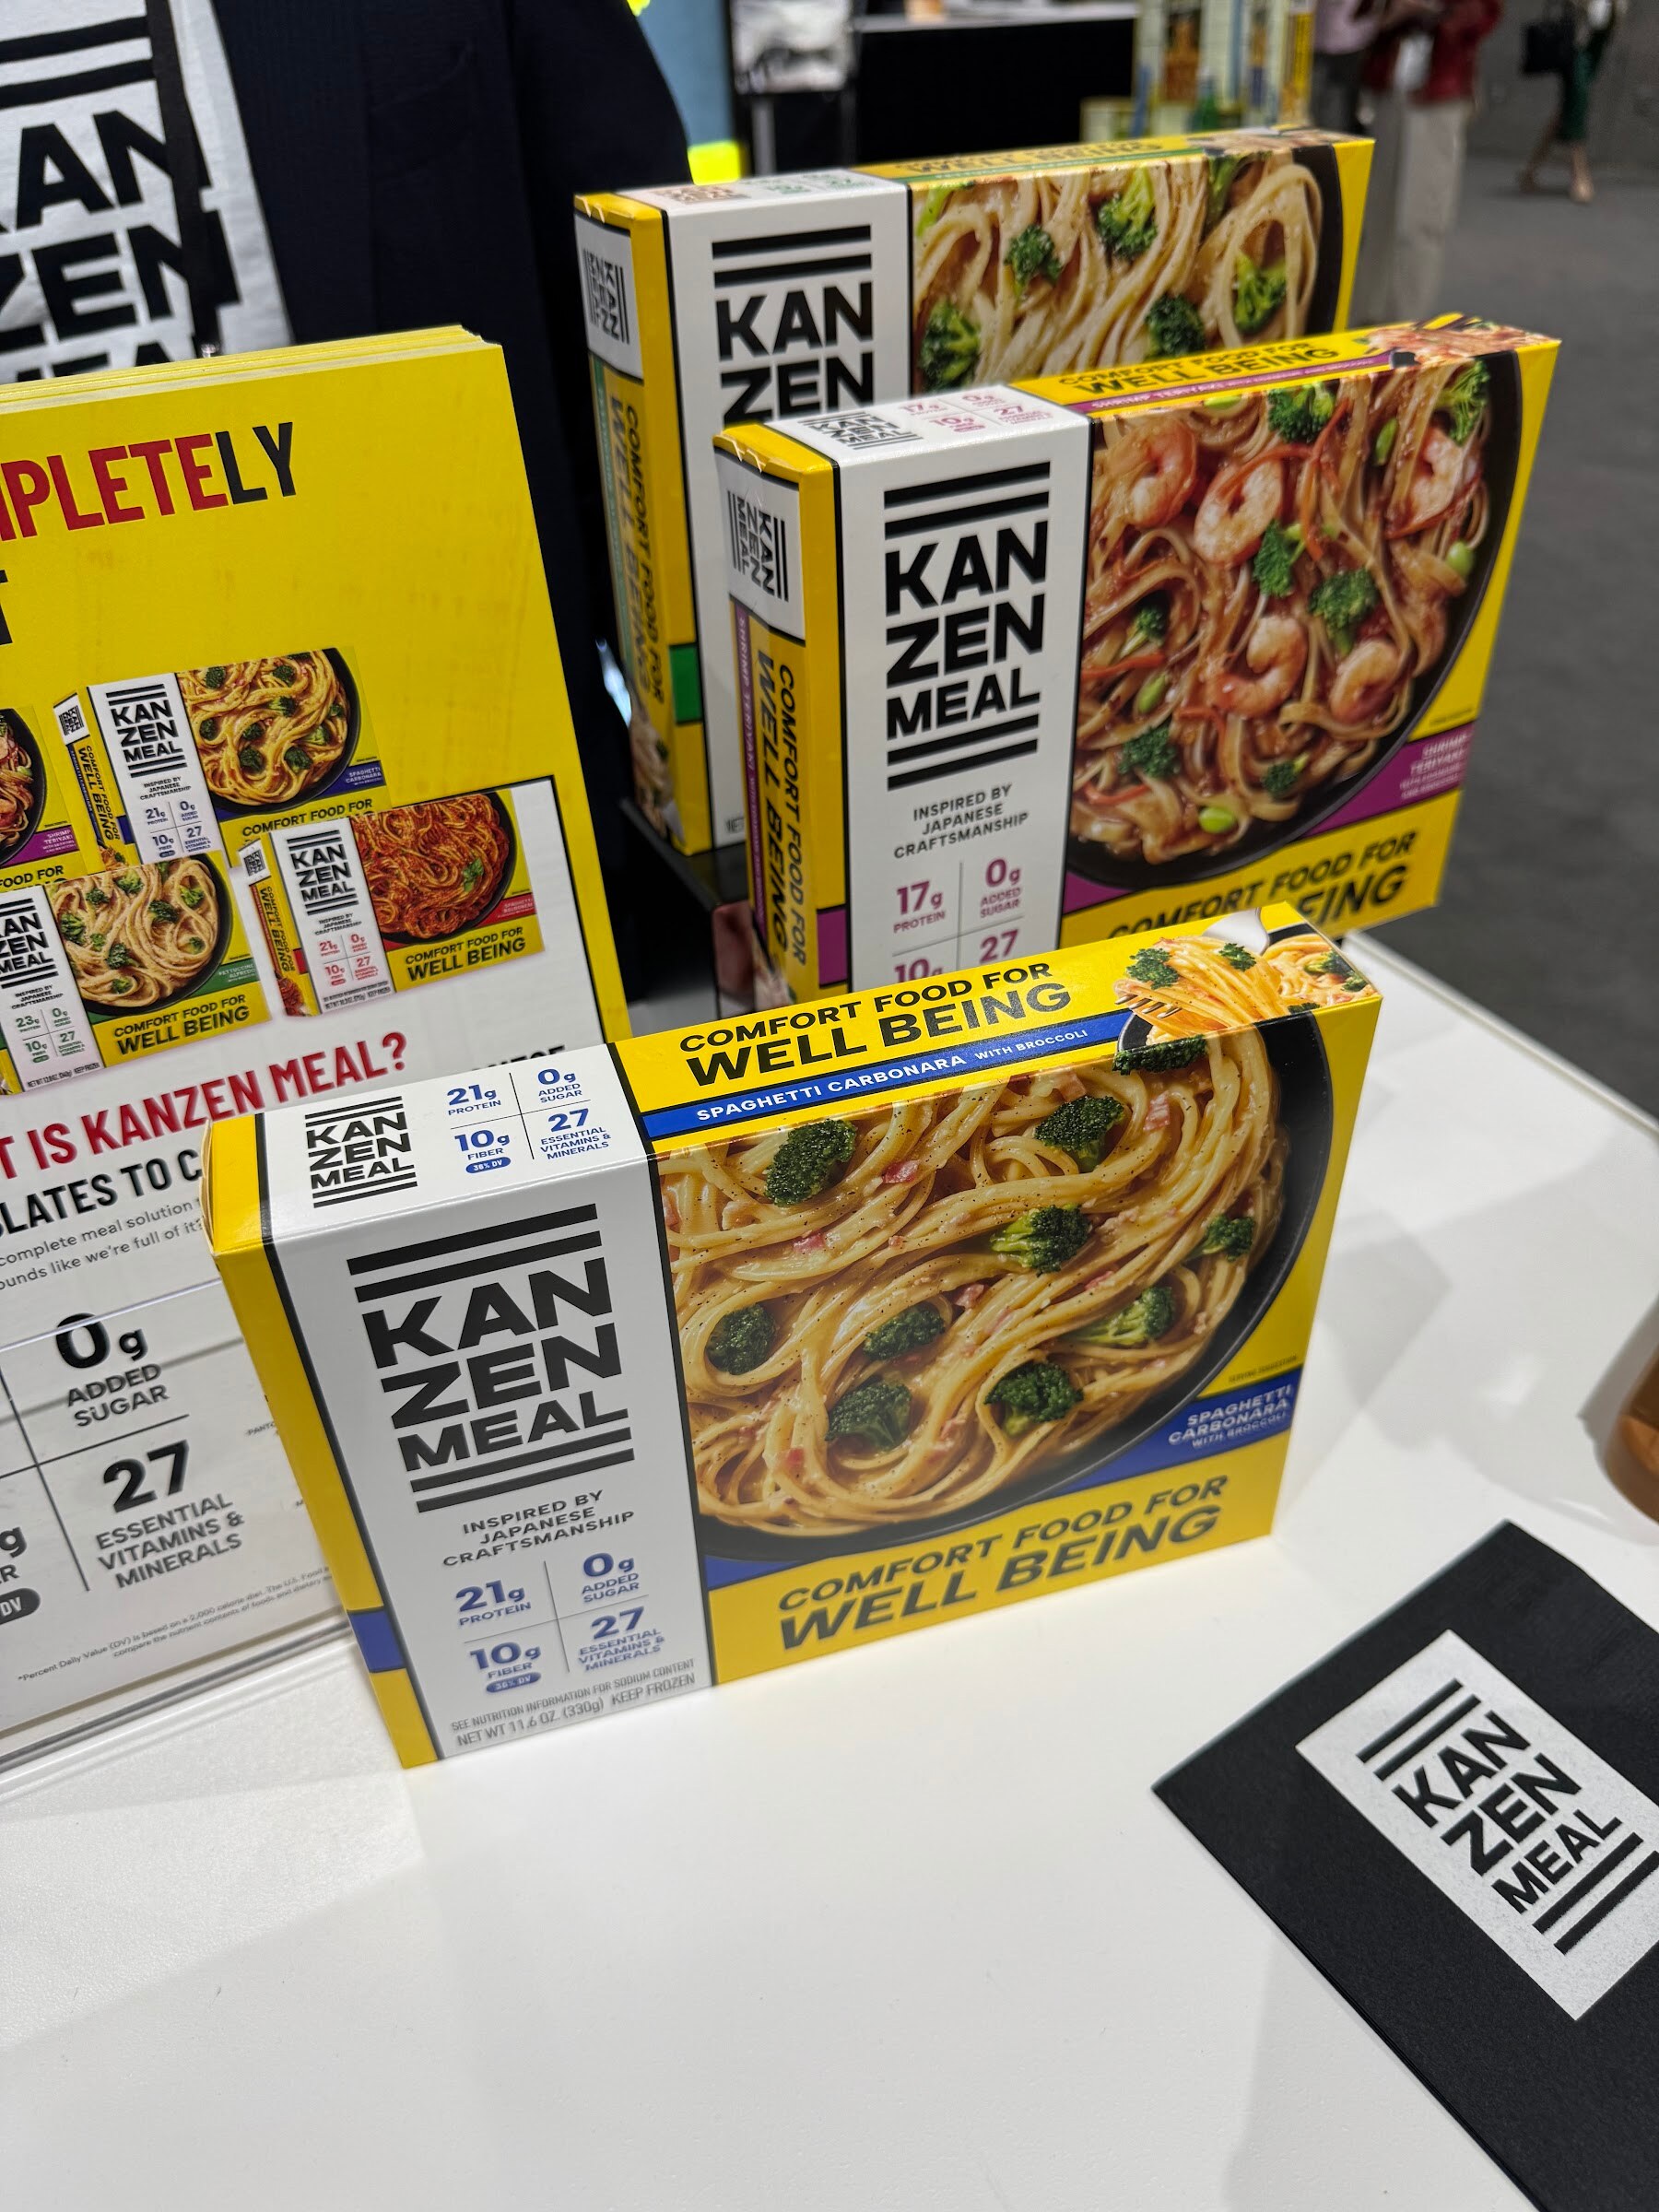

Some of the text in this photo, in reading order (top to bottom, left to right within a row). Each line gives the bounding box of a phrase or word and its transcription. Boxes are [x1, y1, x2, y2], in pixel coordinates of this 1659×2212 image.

[0, 97, 212, 232] AN
[716, 281, 873, 361] KAN
[721, 351, 873, 427] ZEN
[1059, 362, 1182, 384] COMFORT
[1074, 371, 1207, 394] WELL
[1205, 349, 1338, 375] BEING
[808, 415, 887, 431] KAN
[824, 422, 901, 439] ZEN
[837, 430, 912, 445] MEAL
[0, 421, 296, 542] PLETELY
[627, 405, 665, 704] COMFORT FOOD FOR
[736, 497, 749, 576] MEAL
[746, 501, 761, 587] ZEN
[758, 510, 775, 596] KAN
[885, 520, 1048, 618] KAN
[886, 593, 1045, 689] ZEN
[111, 699, 173, 726] KAN
[757, 649, 781, 789] WELL
[887, 666, 1041, 741] MEAL
[117, 719, 180, 747] ZEN
[123, 740, 182, 763] MEAL
[77, 747, 94, 790] WELL
[92, 793, 114, 841] BEING
[913, 783, 1013, 821] INSPIRED BY
[186, 826, 202, 838] 27
[242, 799, 372, 837] COMFORT FOOD FOR
[780, 664, 806, 966] COMFORT FOOD FOR
[922, 803, 1003, 835] JAPANESE
[893, 811, 1030, 859] CRAFTSMANSHIP
[37, 865, 64, 879] FOR
[289, 844, 348, 870] KAN
[296, 862, 352, 888] ZEN
[766, 798, 788, 953] BEING
[984, 857, 1021, 888] 0g
[1269, 852, 1353, 899] FOOD
[1359, 830, 1416, 867] FOR
[300, 881, 356, 902] MEAL
[896, 880, 943, 915] 17g
[980, 888, 1021, 906] ADDED
[980, 899, 1021, 918] SUGAR
[260, 888, 290, 971] WELL BEING
[893, 911, 946, 934] PROTEIN
[357, 956, 371, 968] 27
[406, 926, 524, 965] COMFORT FOOD FOR
[407, 958, 464, 982] WELL
[467, 937, 525, 966] BEING
[979, 928, 1019, 964] 27
[114, 994, 246, 1038] COMFORT FOOD FOR
[679, 961, 1053, 1053] COMFORT FOOD FOR
[60, 1030, 76, 1042] 27
[117, 1029, 180, 1055] WELL
[184, 1006, 250, 1037] BEING
[686, 982, 1072, 1088] WELL BEING
[447, 1084, 497, 1105] 21g
[537, 1068, 576, 1085] 0g
[538, 1083, 581, 1096] ADDED
[696, 1029, 1088, 1122] SPAGHETTI CARBONARA WITH BROCCOLI
[27, 1032, 407, 1170] IS KANZEN MEAL?
[448, 1100, 501, 1115] PROTEIN
[540, 1090, 582, 1103] SUGAR
[307, 1112, 409, 1149] KAN
[541, 1126, 606, 1145] ESSENTIAL
[547, 1108, 589, 1133] 27
[308, 1133, 412, 1171] ZEN
[454, 1130, 510, 1152] 10g
[467, 1147, 504, 1160] FIBER
[540, 1135, 599, 1152] VITAMINS
[547, 1141, 609, 1159] MINERALS
[311, 1157, 414, 1190] MEAL
[0, 1158, 172, 1238] LATES TO
[82, 1219, 123, 1241] meal
[127, 1202, 193, 1229] solution
[51, 1225, 180, 1275] like we're full of
[362, 1256, 613, 1370] KAN
[55, 1312, 148, 1369] 0g
[67, 1363, 161, 1407] ADDED
[381, 1322, 622, 1430] ZEN
[75, 1384, 170, 1427] SUGAR
[1168, 1398, 1288, 1445] CARBONARA
[1188, 1384, 1292, 1427] SPAGHETTI
[397, 1390, 629, 1472] MEAL
[1192, 1412, 1286, 1449] WITH BROCCOLI
[103, 1440, 190, 1512] 27
[96, 1493, 233, 1549] ESSENTIAL
[463, 1489, 603, 1535] INSPIRED BY
[479, 1506, 595, 1545] JAPANESE
[98, 1510, 245, 1571] VITAMINS &
[442, 1511, 635, 1568] CRAFTSMANSHIP
[778, 1475, 1228, 1612] COMFORT FOOD FOR
[115, 1533, 242, 1589] MINERALS
[582, 1552, 635, 1578] 0g
[779, 1505, 1221, 1652] WELL BEING
[455, 1580, 525, 1613] 21g
[582, 1571, 639, 1594] ADDED
[582, 1582, 641, 1604] SUGAR
[459, 1601, 532, 1627] PROTEIN
[591, 1606, 644, 1641] 27
[59, 1653, 81, 1668] Daily
[83, 1646, 108, 1659] Value
[469, 1641, 542, 1671] 10g
[578, 1635, 665, 1665] VITAMINS &
[579, 1628, 662, 1654] ESSENTIAL
[584, 1645, 662, 1672] MINERALS
[488, 1662, 533, 1679] FIBER
[518, 1674, 531, 1685] DV
[452, 1658, 695, 1732] SEE NUTRITION INFORMATION FOR SODIUM CONTENT
[456, 1673, 696, 1747] NET WT 11.6 (330g) KEEP FROZEN
[1391, 1710, 1531, 1829] KAN
[1440, 1752, 1582, 1877] ZEN
[1491, 1809, 1623, 1915] MEAL
